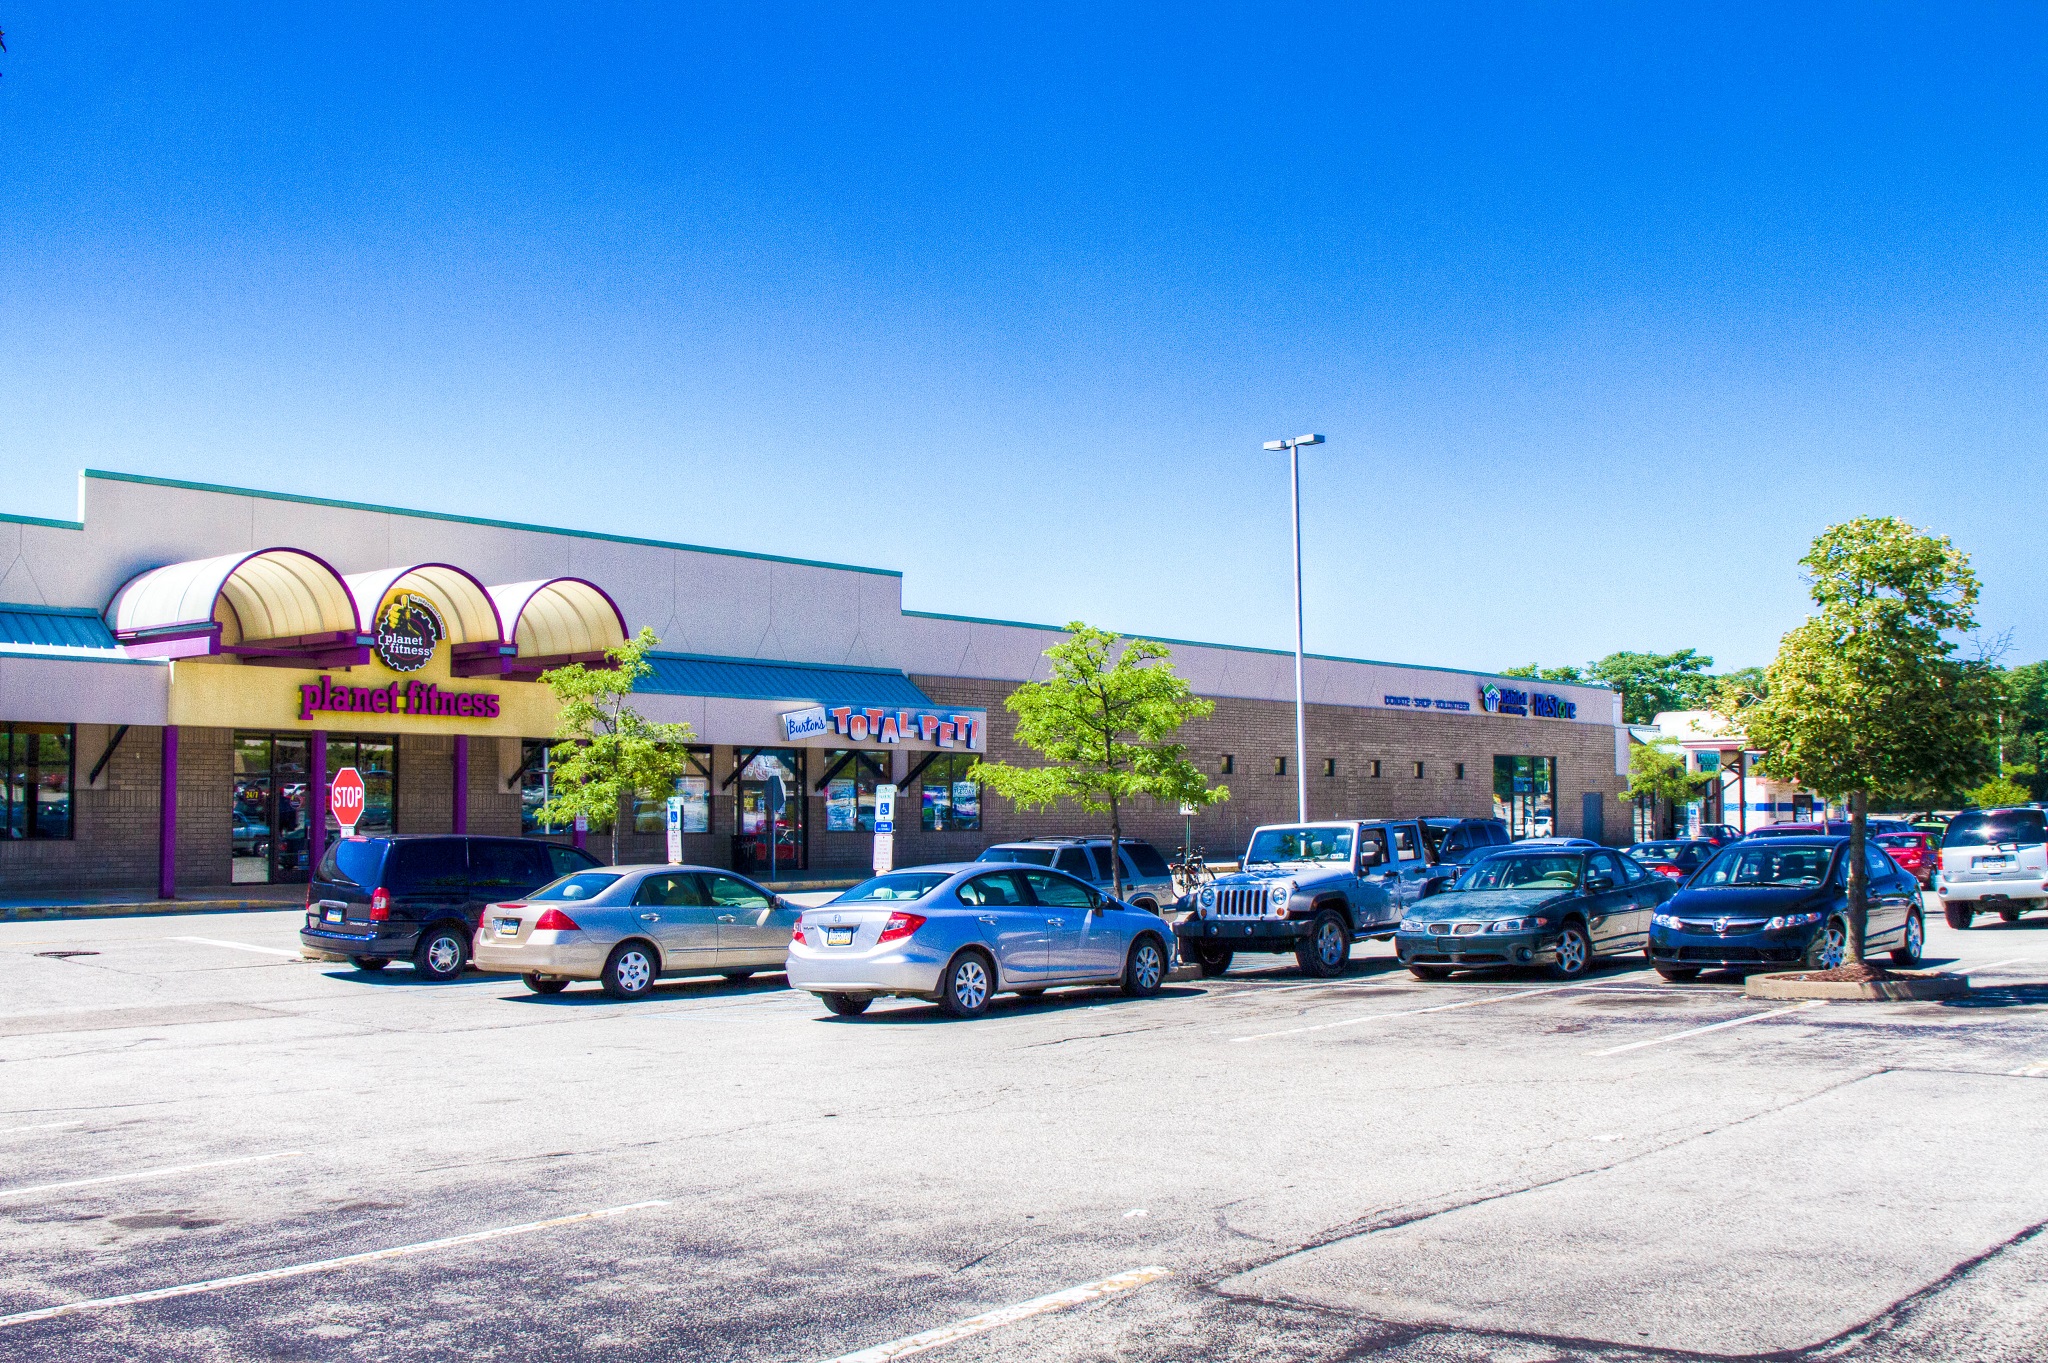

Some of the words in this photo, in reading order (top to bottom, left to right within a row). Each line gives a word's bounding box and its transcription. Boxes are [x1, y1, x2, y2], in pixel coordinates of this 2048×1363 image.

[385, 633, 423, 646] planet
[389, 643, 430, 656] fitness
[299, 675, 400, 720] planet
[405, 680, 500, 718] fitness
[1534, 693, 1577, 719] ReStore
[787, 716, 827, 735] Burton's
[829, 706, 914, 744] TOTAL
[246, 791, 258, 799] 24/7
[334, 787, 362, 808] STOP
